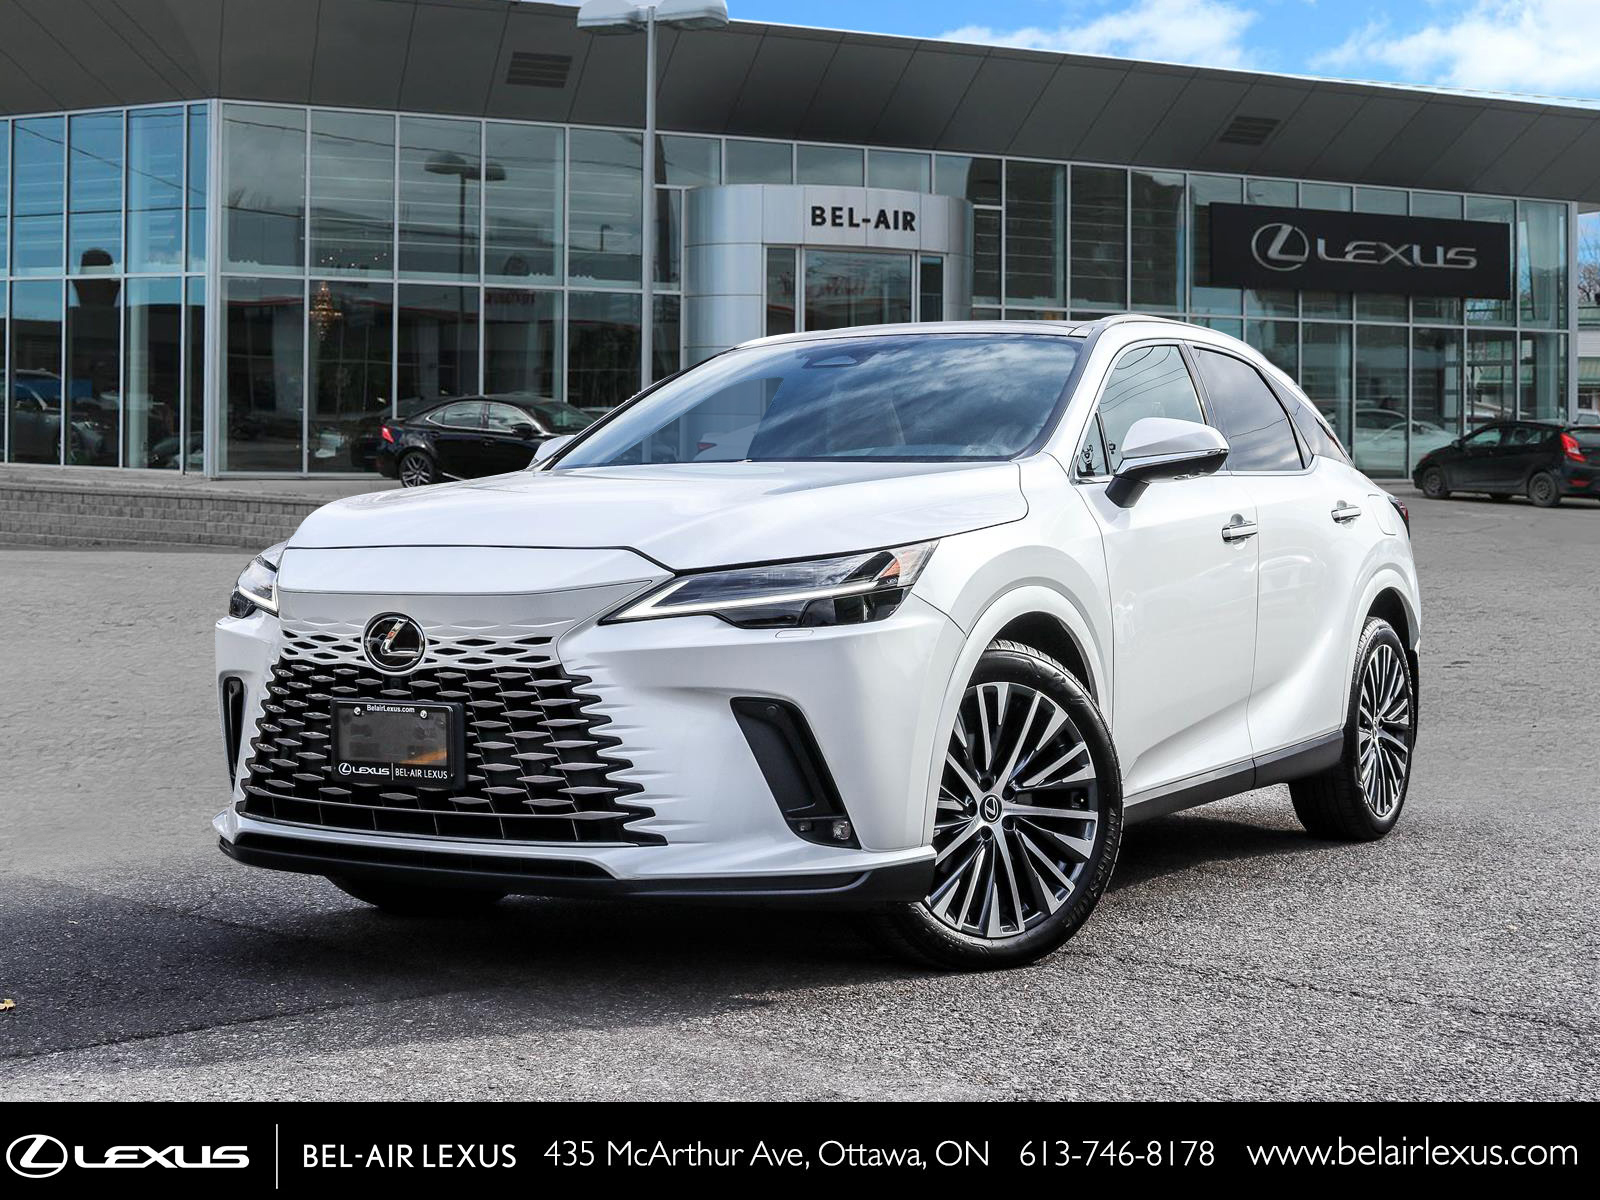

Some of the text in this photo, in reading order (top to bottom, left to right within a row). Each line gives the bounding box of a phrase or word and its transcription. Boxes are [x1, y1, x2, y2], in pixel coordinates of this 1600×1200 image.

[811, 206, 916, 231] BEL-AIR
[1317, 238, 1477, 269] LEXUS
[366, 704, 415, 713] BelairLexus.com
[352, 767, 390, 776] LEXUS
[395, 768, 448, 780] BEL-AIR LEXUS
